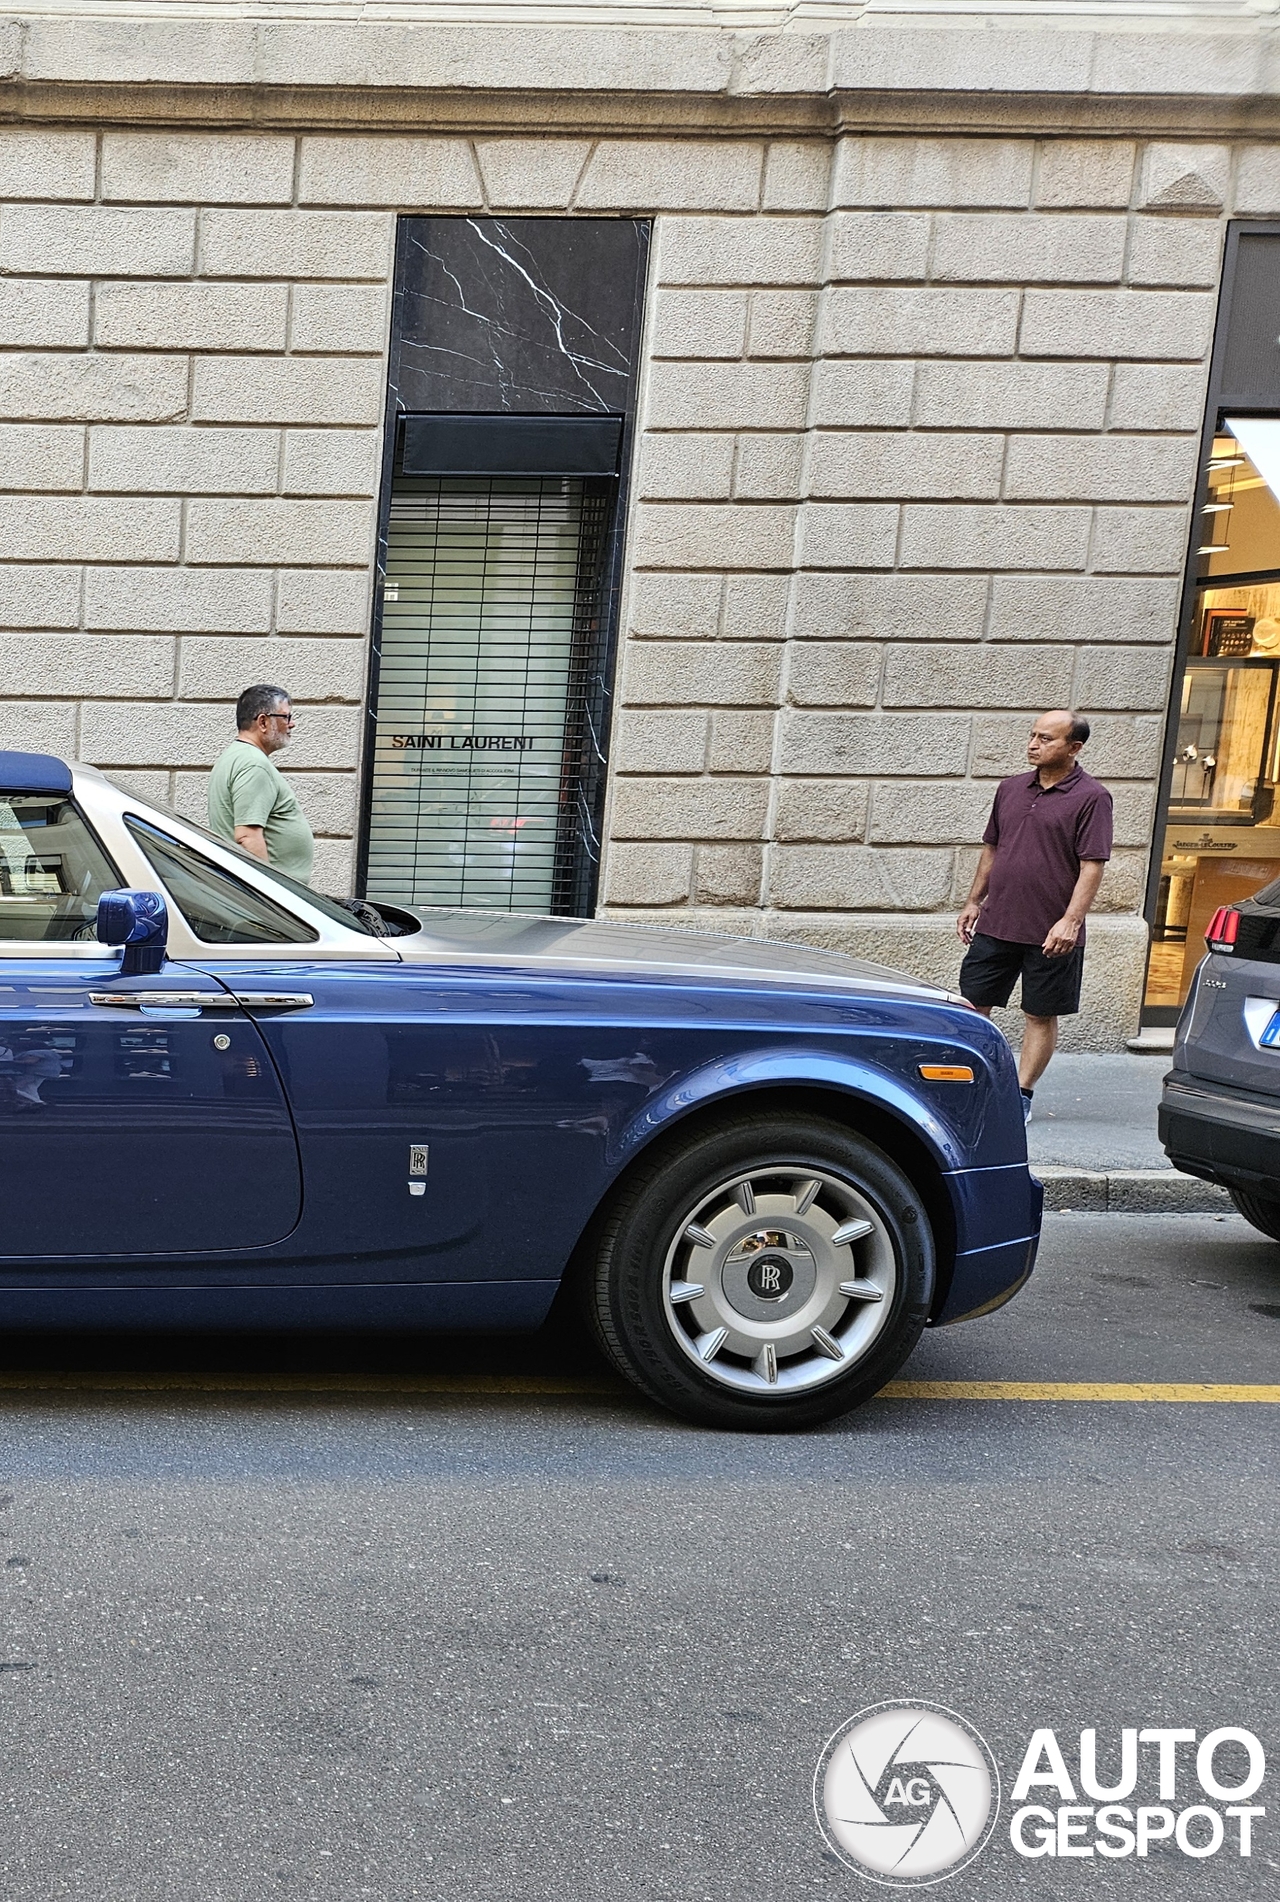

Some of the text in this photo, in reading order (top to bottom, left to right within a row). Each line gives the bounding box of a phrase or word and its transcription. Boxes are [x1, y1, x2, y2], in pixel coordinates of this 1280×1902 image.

[392, 736, 535, 750] SAINT LAURENT
[761, 1265, 781, 1290] RR
